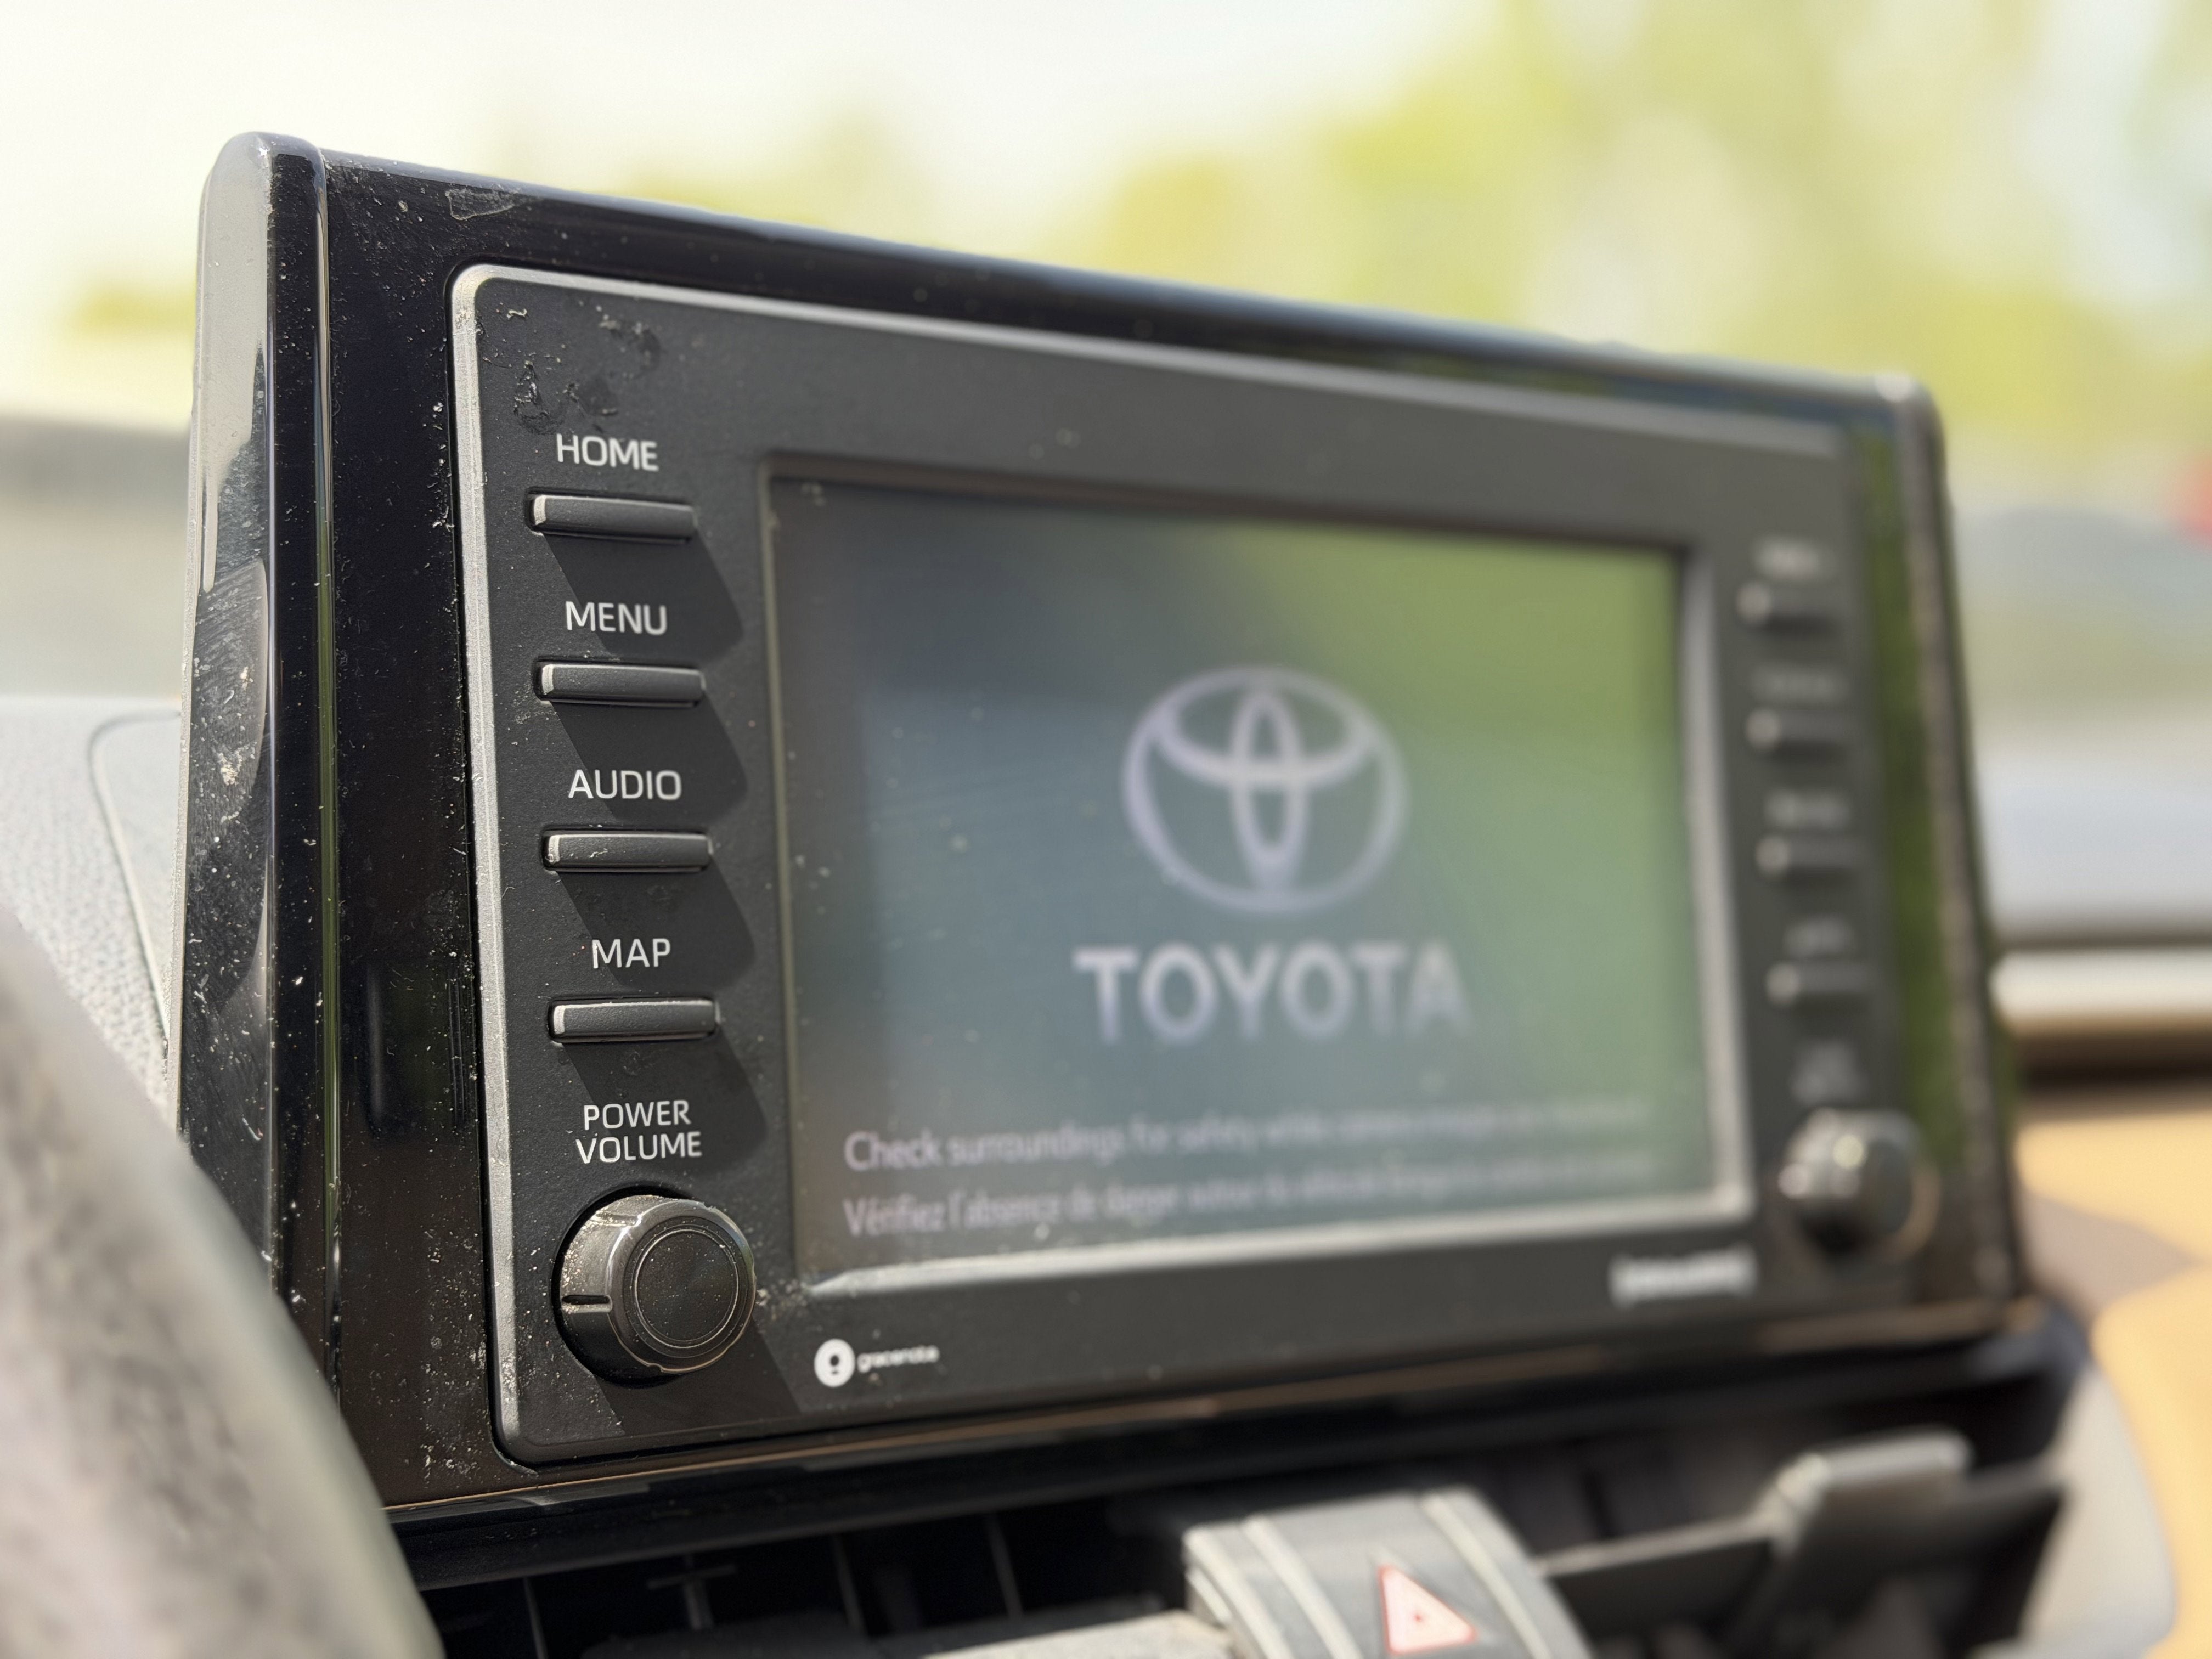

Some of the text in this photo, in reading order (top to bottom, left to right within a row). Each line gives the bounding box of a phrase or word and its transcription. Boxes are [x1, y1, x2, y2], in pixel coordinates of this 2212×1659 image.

[556, 433, 659, 472] HOME
[565, 600, 667, 635] MENU
[567, 769, 681, 800] AUDIO
[591, 938, 671, 969] MAP
[1071, 940, 1473, 1046] TOYOTA
[583, 1099, 691, 1131] POWER
[575, 1131, 702, 1165] VOLUME
[844, 1127, 943, 1172] Check
